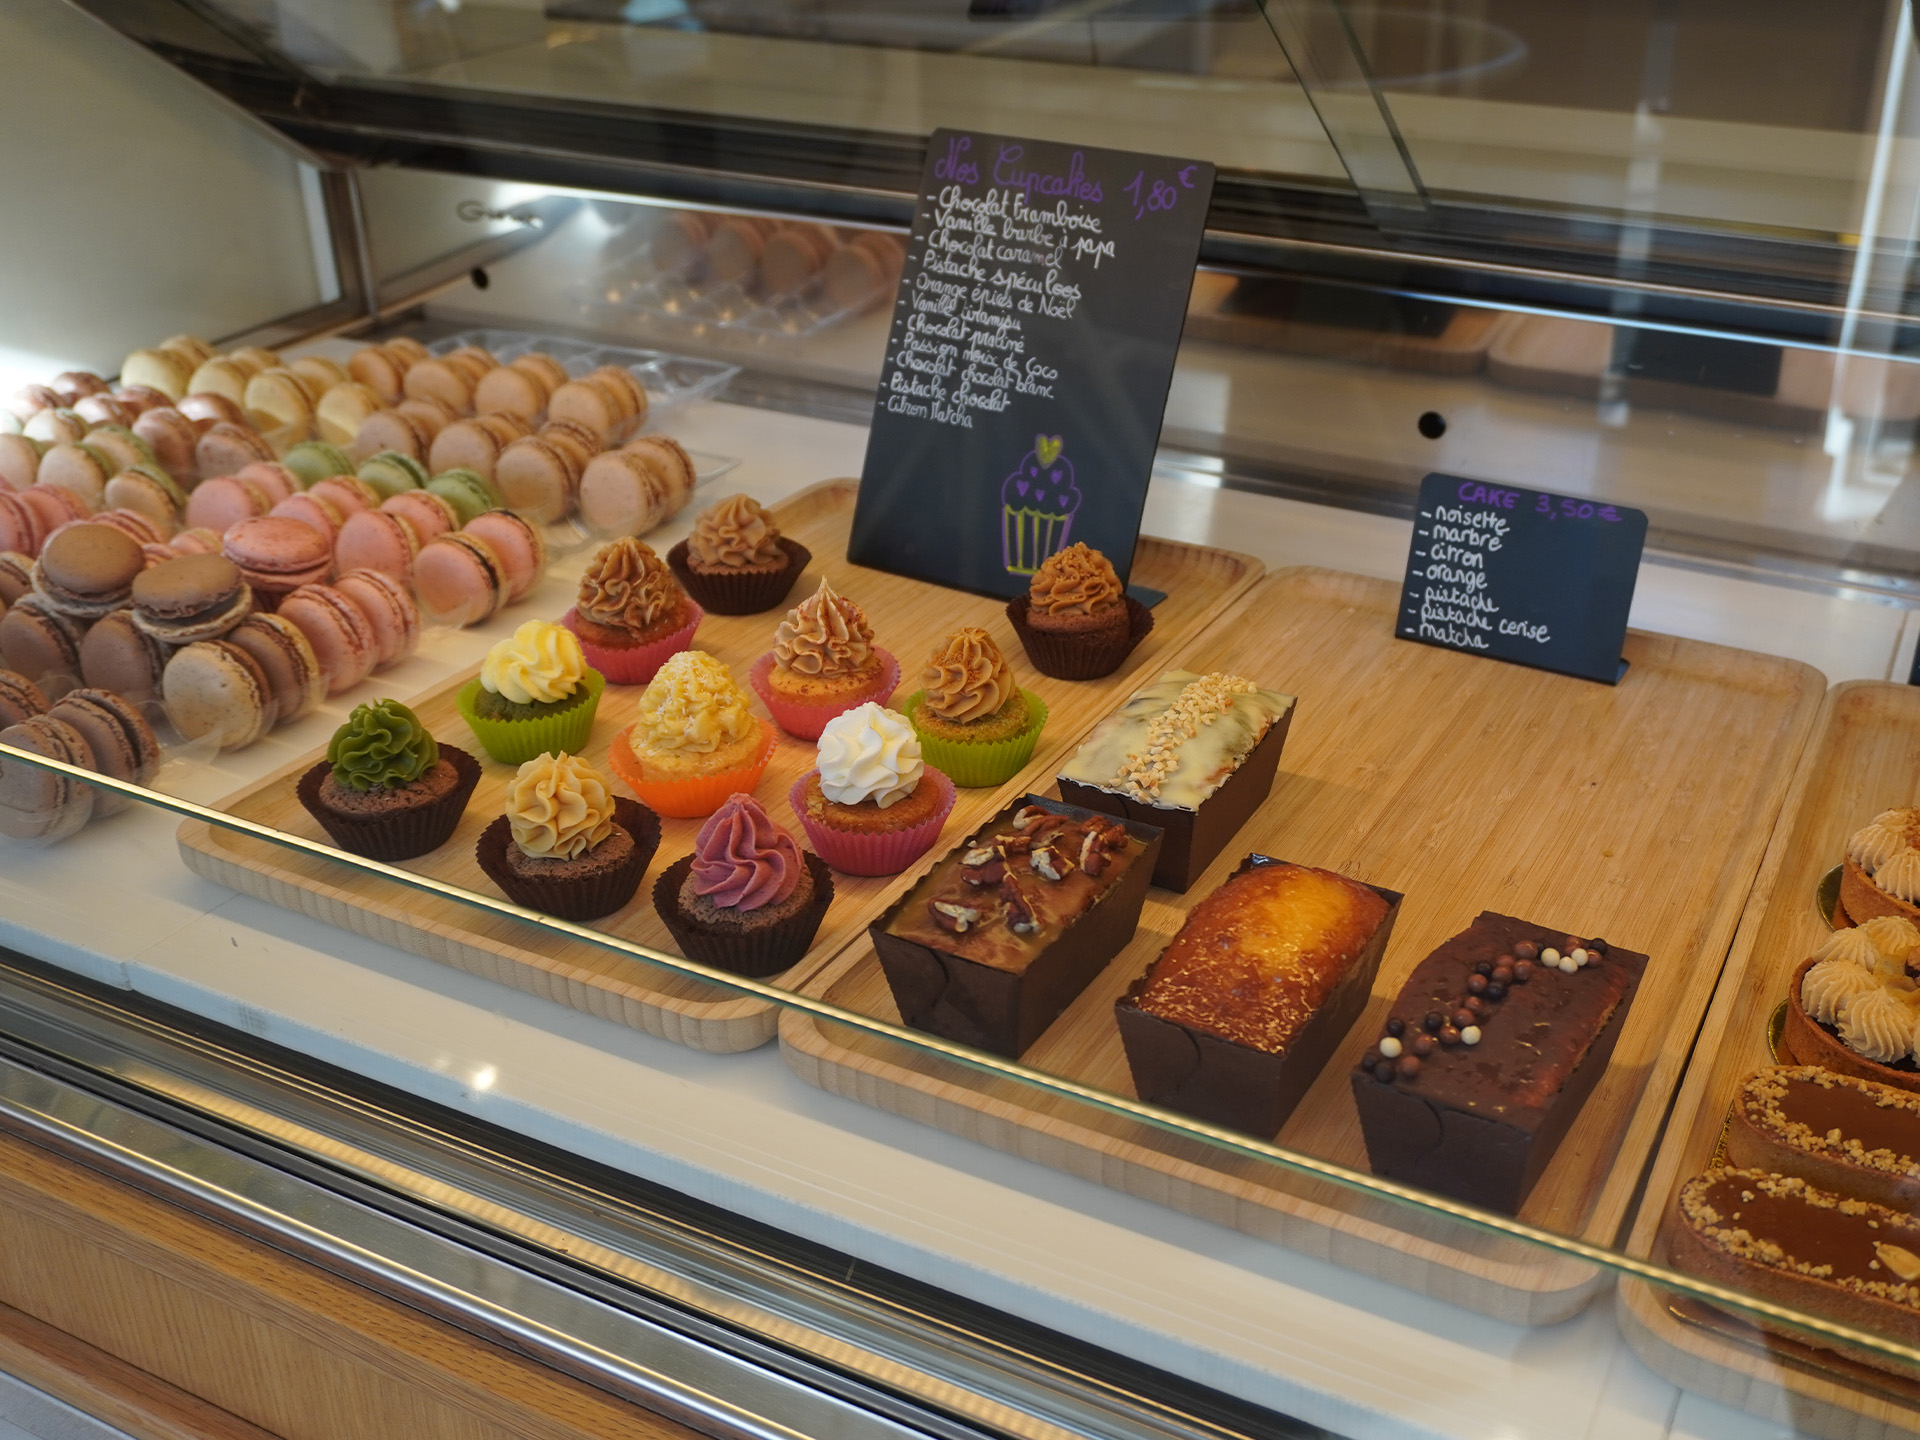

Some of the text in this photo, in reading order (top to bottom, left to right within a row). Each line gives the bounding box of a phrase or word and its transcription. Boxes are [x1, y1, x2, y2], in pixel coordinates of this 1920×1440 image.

[935, 136, 979, 185] Nos
[993, 143, 1103, 204] Cupcakes
[939, 185, 1102, 234] Chocolat Framboise
[928, 228, 1062, 269] Chocolat caramel
[935, 208, 997, 236] Vanille
[1002, 217, 1054, 247] barbe
[1070, 236, 1115, 269] papa
[923, 249, 986, 282] Pistache
[912, 289, 1022, 330] Vanille tiramisu
[916, 272, 967, 299] Orange
[1017, 294, 1033, 313] de
[1038, 294, 1076, 319] Noël
[903, 331, 957, 357] Passion
[962, 349, 998, 367] noix
[1003, 352, 1018, 370] de
[907, 313, 1025, 353] Chocolat praliné
[890, 371, 1011, 412] Pistache chocolat
[896, 351, 1054, 398] Chocolat chocolat blanc
[887, 394, 973, 428] Citron Matcha
[1458, 481, 1520, 509] CAKE
[1435, 505, 1510, 534] noisette
[1430, 541, 1483, 569] citron
[1424, 585, 1499, 612] pistache
[1426, 563, 1487, 594] orange
[1419, 622, 1489, 648] matcha
[1420, 603, 1550, 643] pistache cerise
